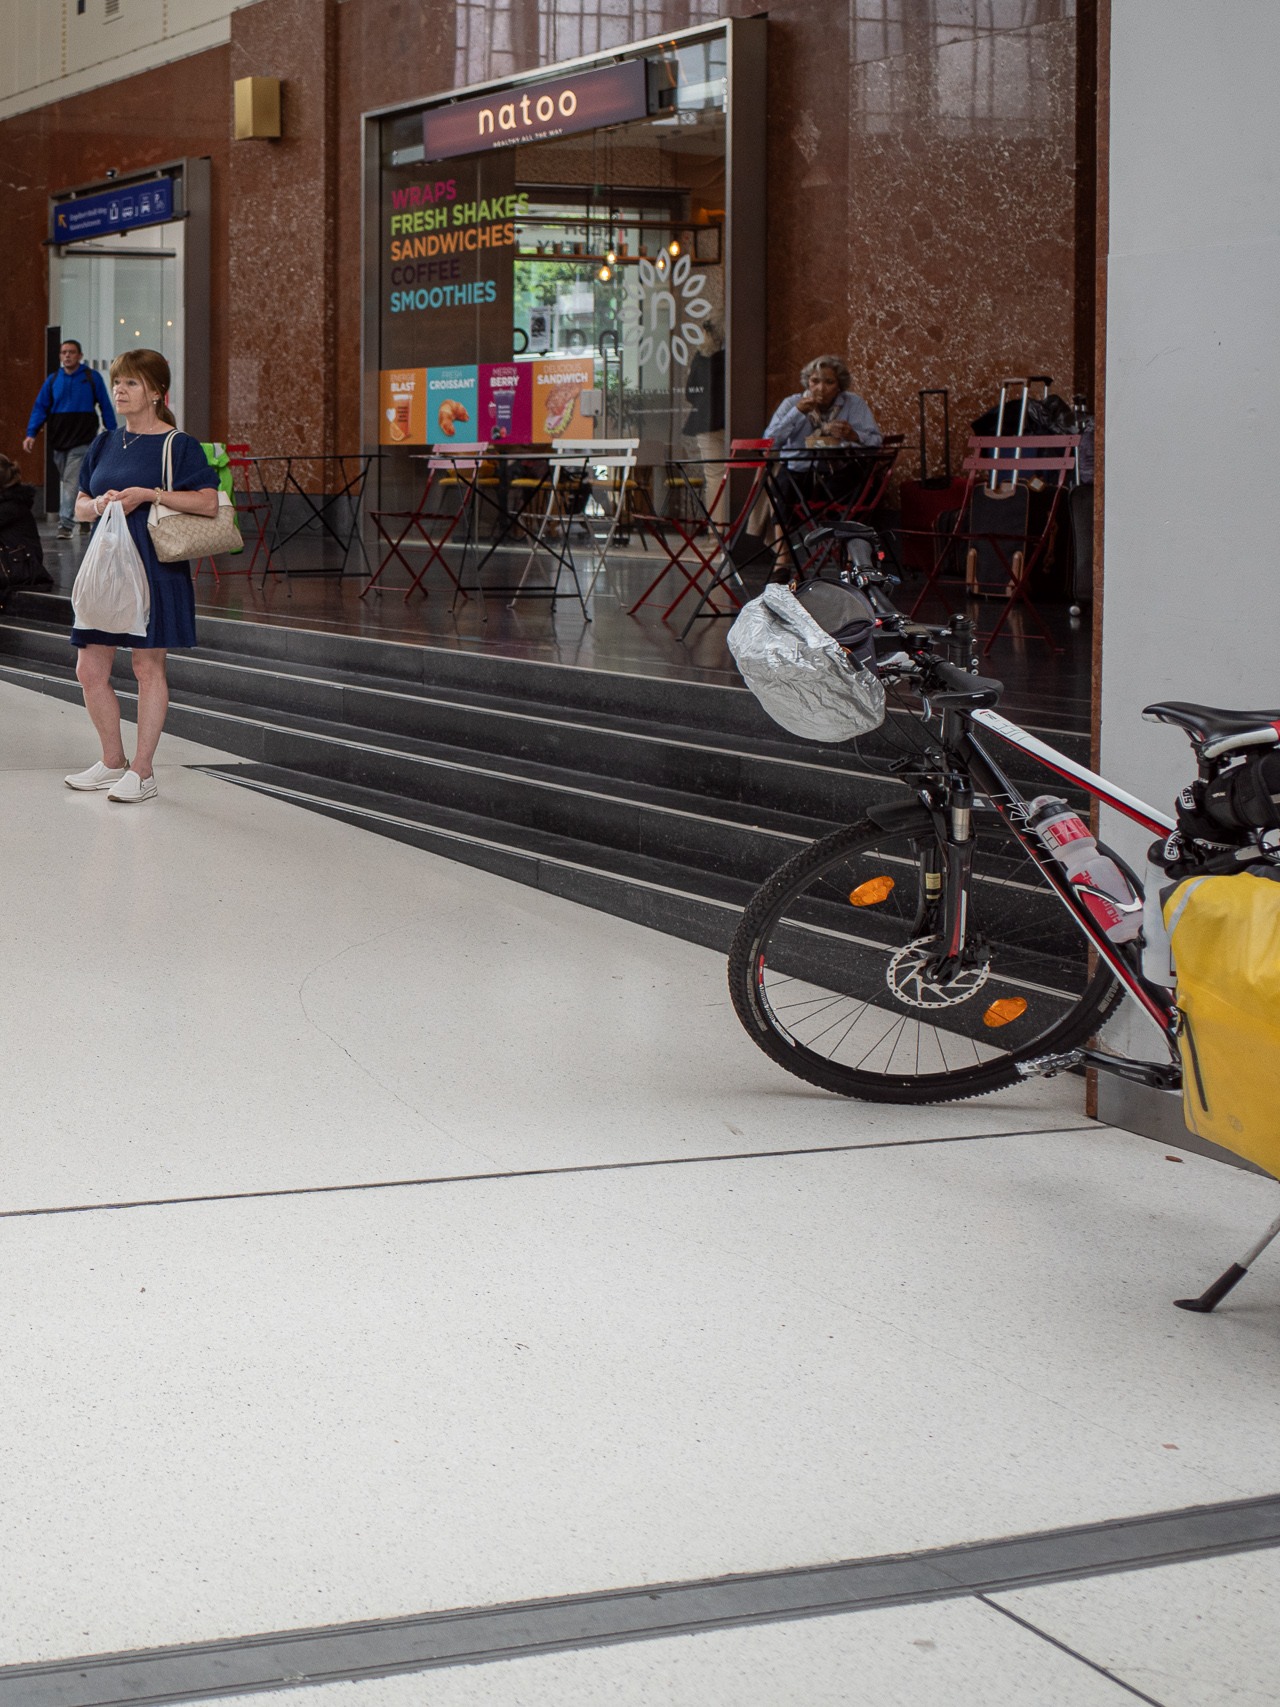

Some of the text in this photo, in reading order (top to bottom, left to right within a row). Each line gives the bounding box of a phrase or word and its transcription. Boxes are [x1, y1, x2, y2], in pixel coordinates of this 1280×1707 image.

[478, 90, 577, 135] natoo
[521, 134, 533, 142] ALL
[549, 128, 564, 136] WAY
[391, 179, 457, 210] WRAPS
[391, 192, 530, 237] FRESH SHAKES
[390, 222, 515, 261] SANDWICHES
[391, 259, 460, 286] COFFEE
[390, 280, 497, 313] SMOOTHIES
[537, 372, 588, 385] SANDWICH
[543, 364, 582, 374] DELICIOUS
[390, 382, 416, 392] BLAST
[429, 378, 475, 390] CROISSANT
[490, 375, 520, 387] BERRY
